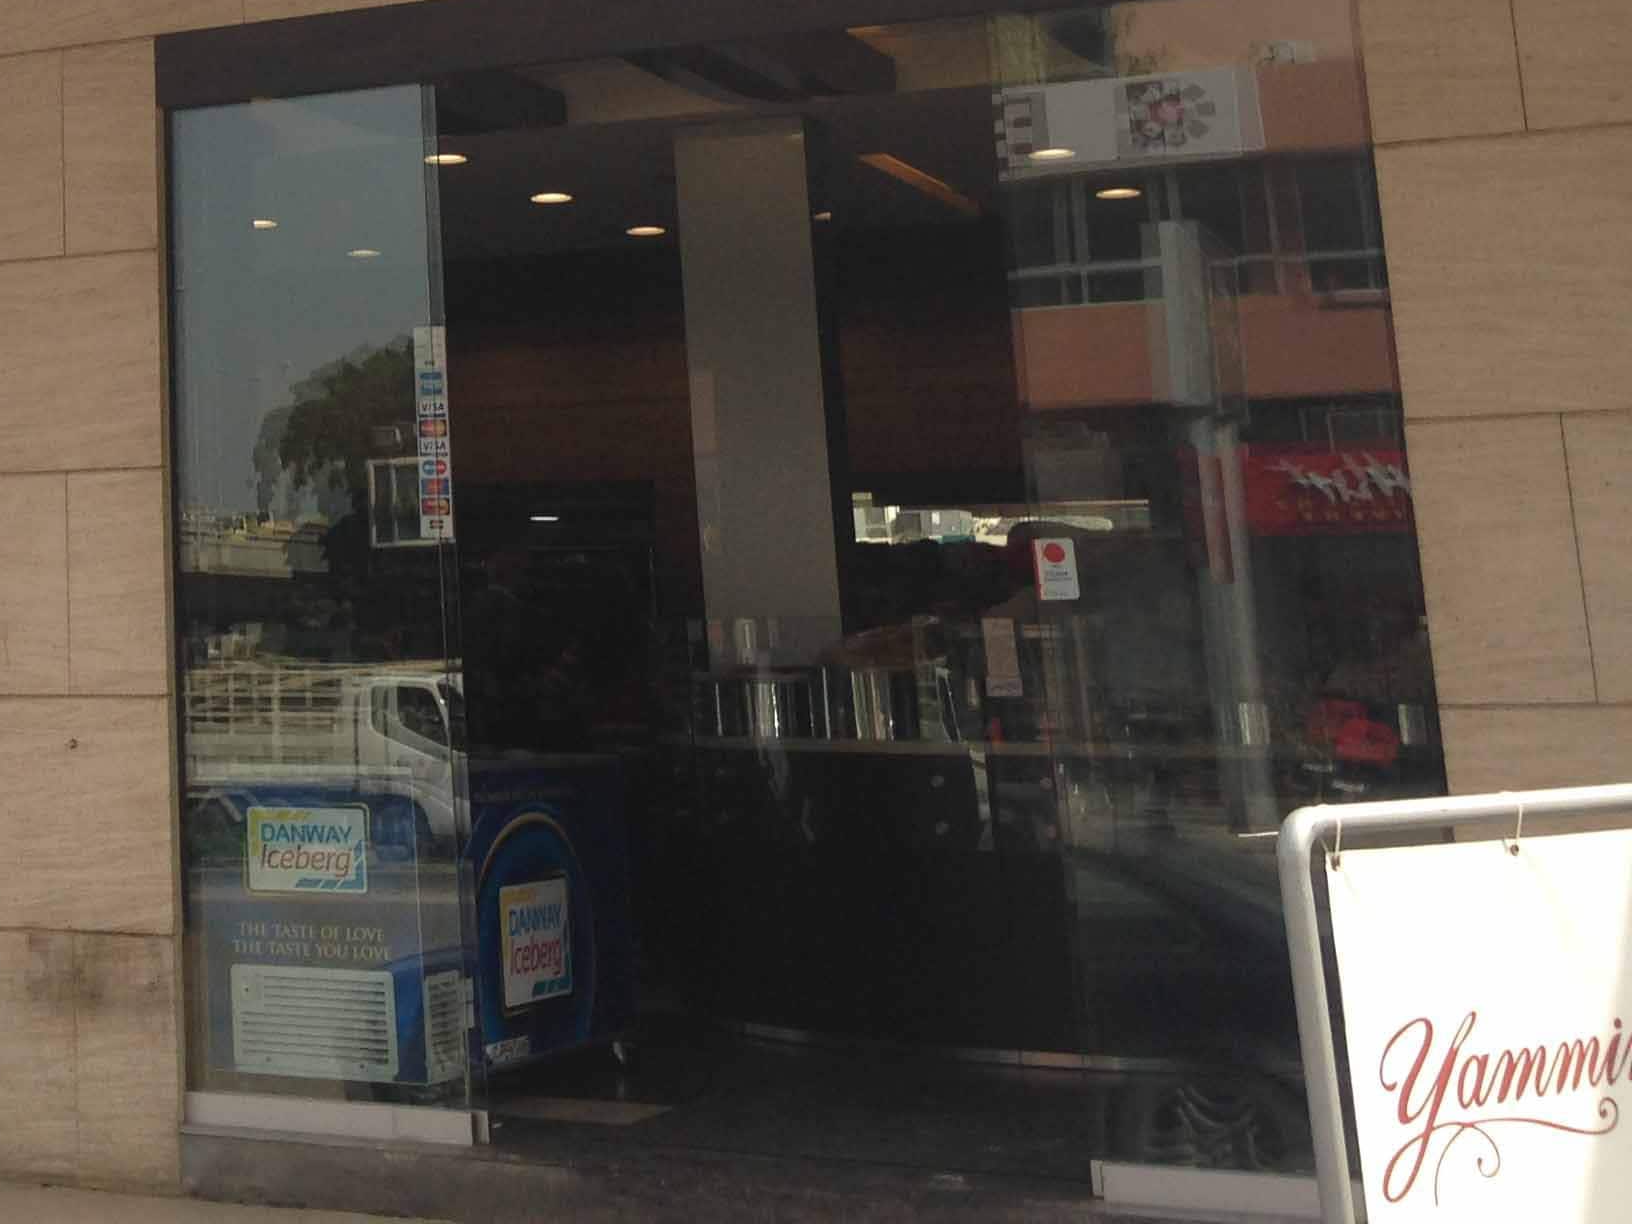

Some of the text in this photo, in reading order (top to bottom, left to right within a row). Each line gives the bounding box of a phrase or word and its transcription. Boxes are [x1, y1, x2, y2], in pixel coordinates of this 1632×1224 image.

[260, 822, 352, 844] DANWAY
[260, 844, 353, 877] Iceberg
[345, 927, 385, 943] LOVE
[509, 904, 562, 937] DANWAY
[510, 937, 562, 975] Iceberg
